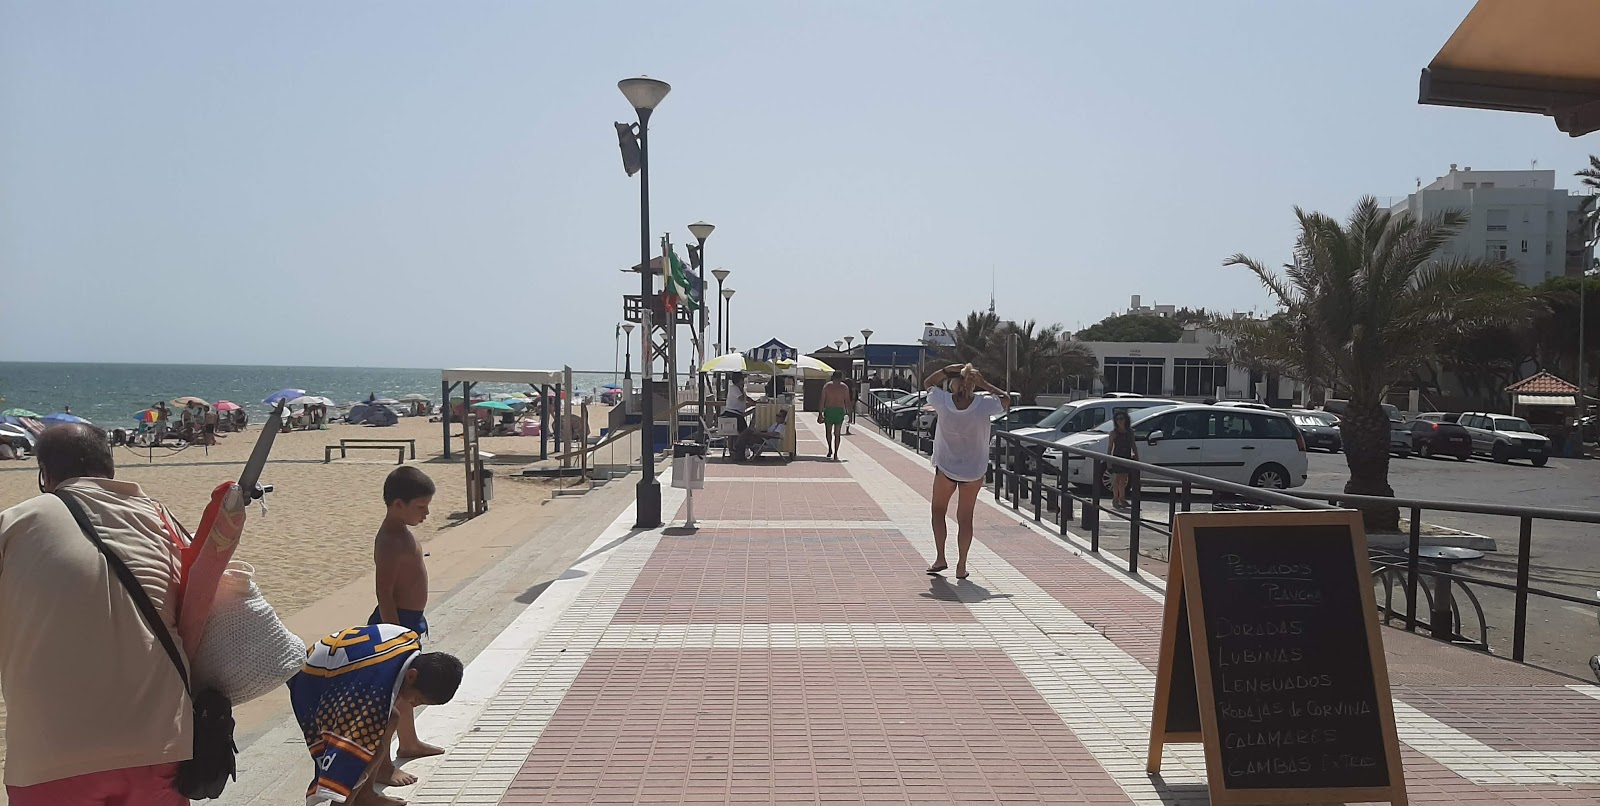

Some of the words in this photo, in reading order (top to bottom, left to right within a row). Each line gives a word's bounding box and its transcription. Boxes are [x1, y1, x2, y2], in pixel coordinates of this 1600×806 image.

[1216, 616, 1304, 639] DORADAS
[1222, 672, 1332, 693] LENGUADOS
[1225, 729, 1337, 749] CALAMARES
[1228, 756, 1311, 776] GAMBAS
